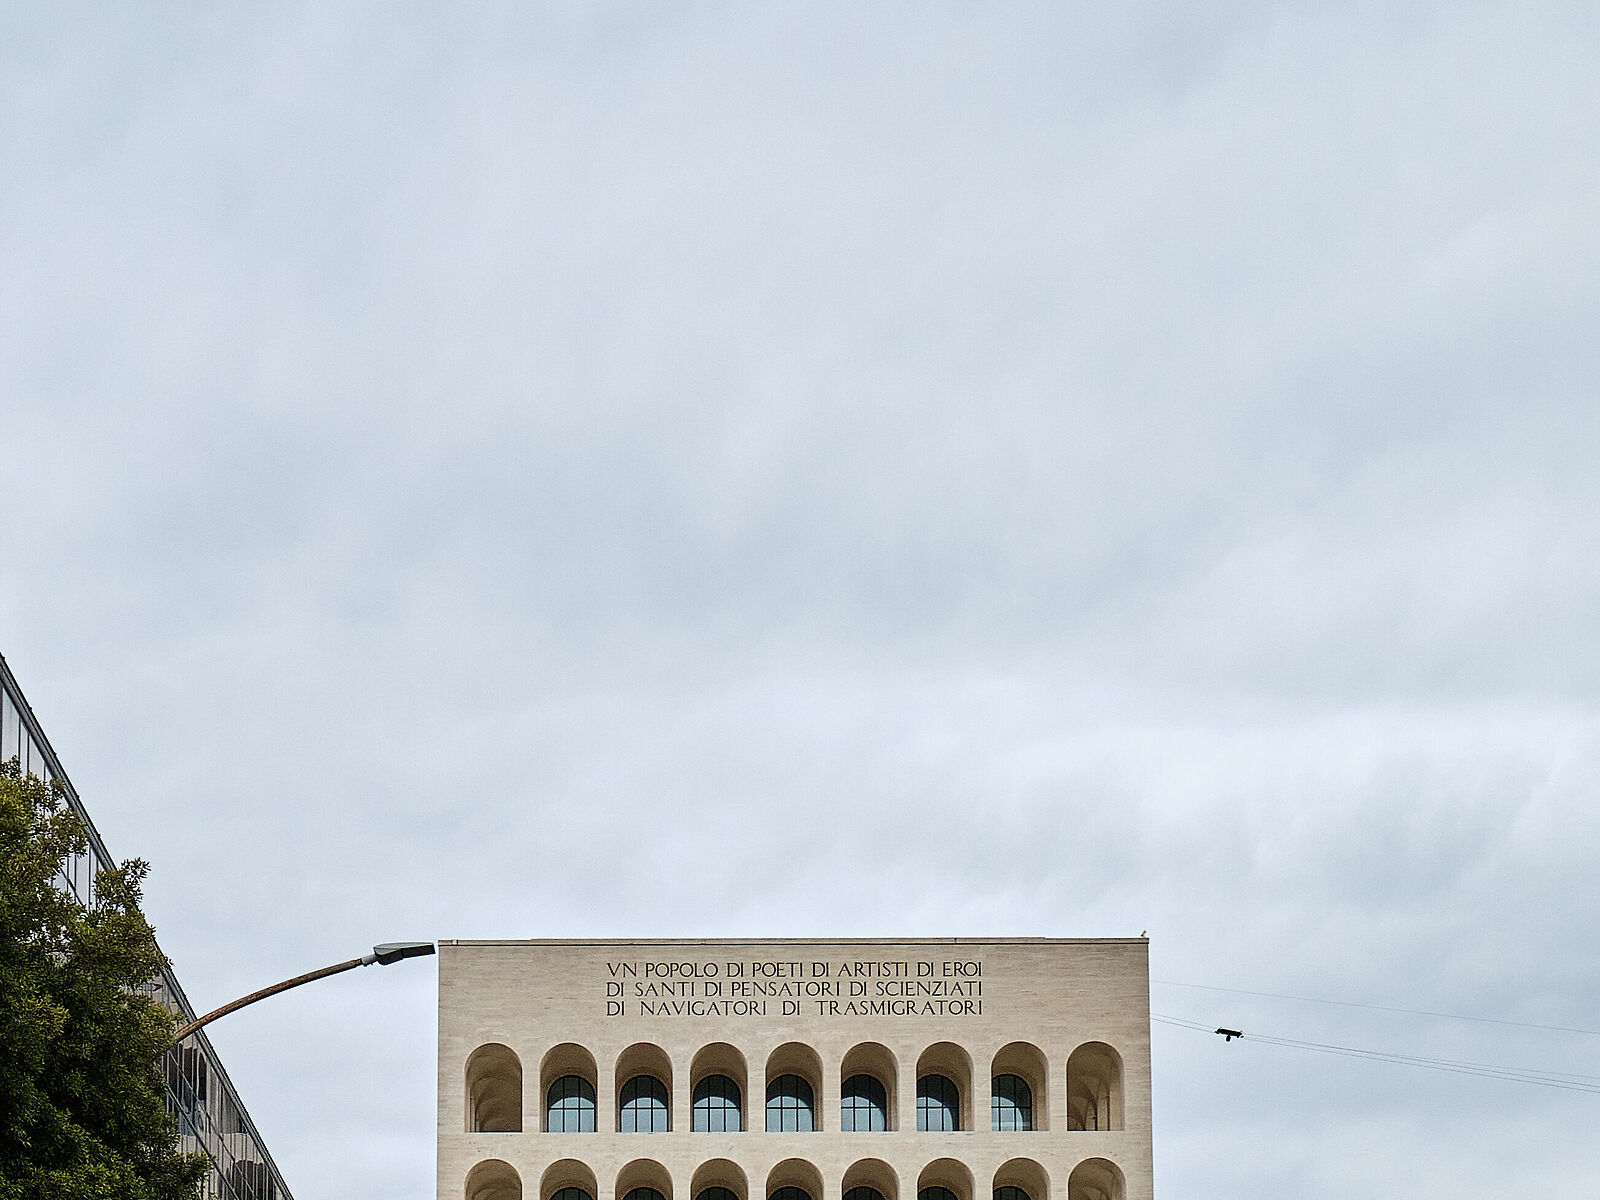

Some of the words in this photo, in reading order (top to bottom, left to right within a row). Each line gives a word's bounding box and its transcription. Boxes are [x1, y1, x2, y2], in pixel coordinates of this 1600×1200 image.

[606, 962, 638, 978] VN
[645, 962, 719, 978] POPOLO
[726, 962, 744, 978] DI
[751, 962, 803, 978] POETI
[811, 962, 830, 978] DI
[837, 962, 908, 978] ARTISTI
[916, 962, 934, 978] DI
[942, 962, 982, 978] EROI
[605, 981, 624, 997] DI
[634, 981, 695, 997] SANTI
[704, 981, 722, 997] DI
[731, 981, 840, 997] PENSATORI
[849, 981, 867, 997] DI
[875, 981, 982, 997] SCIENZIATI
[605, 1000, 625, 1016] DI
[640, 1000, 766, 1016] NAVIGATORI
[782, 1000, 801, 1016] DI
[814, 1000, 982, 1016] TRASMIGRATORI
